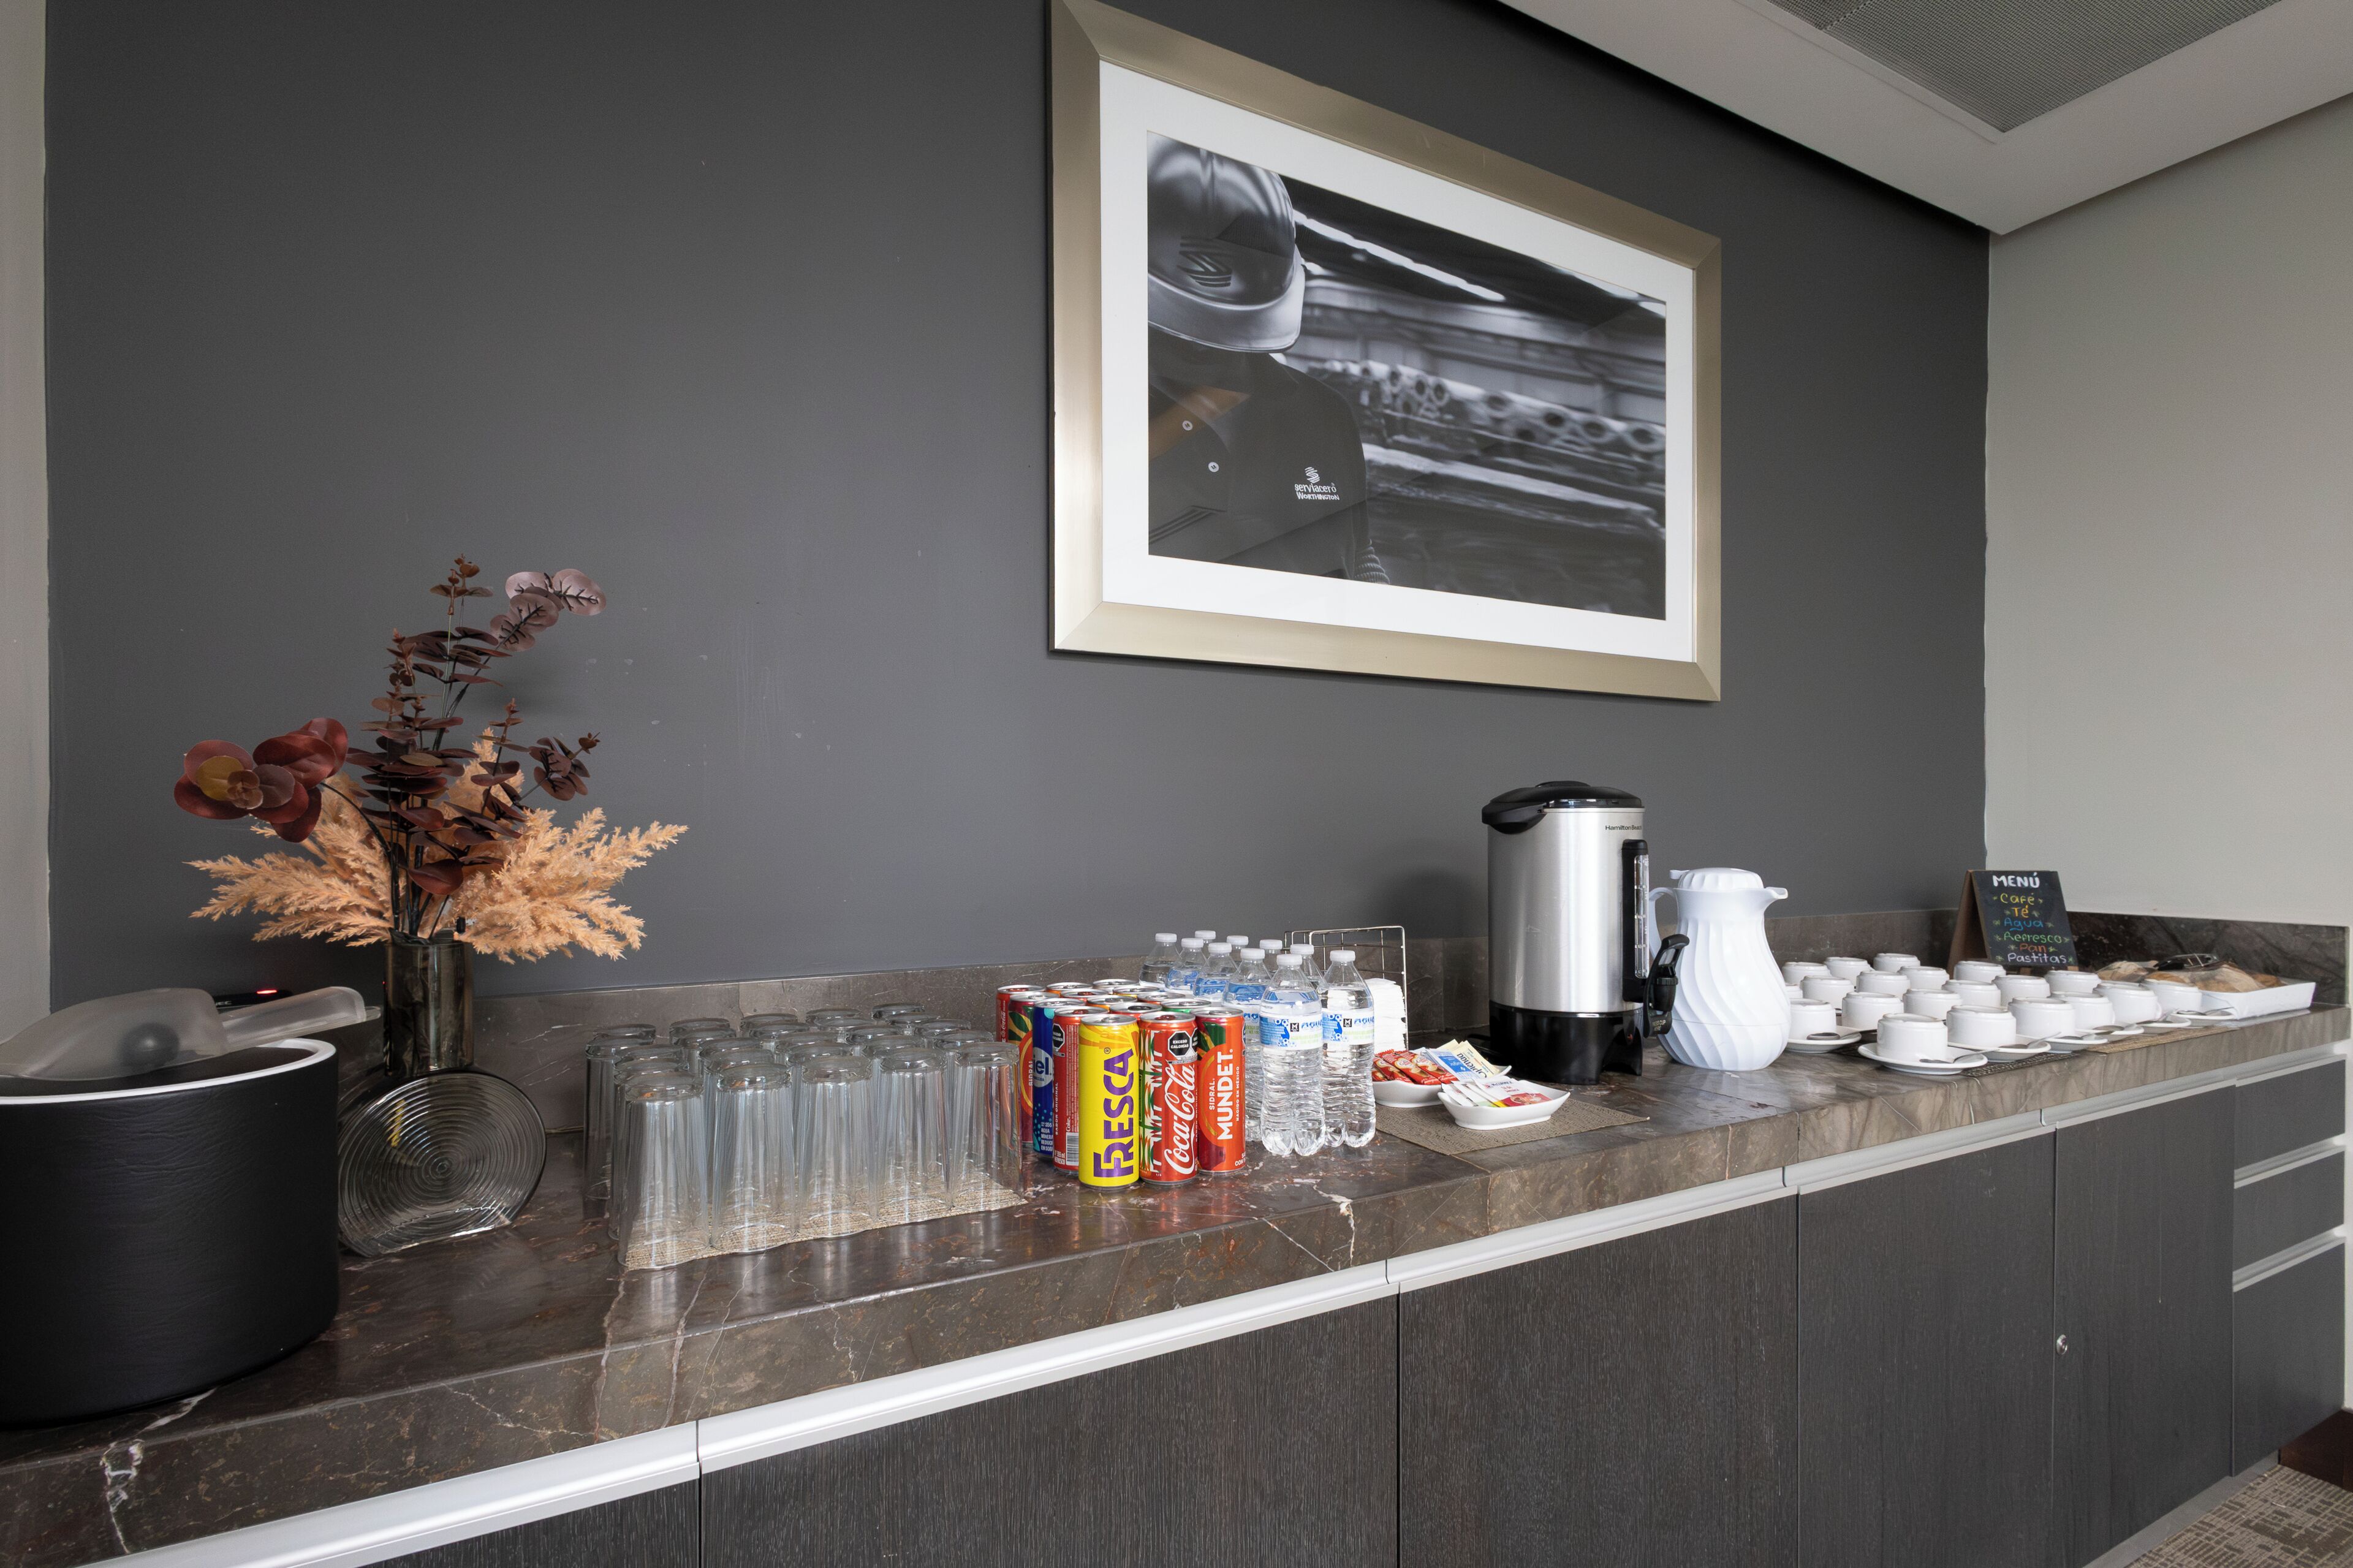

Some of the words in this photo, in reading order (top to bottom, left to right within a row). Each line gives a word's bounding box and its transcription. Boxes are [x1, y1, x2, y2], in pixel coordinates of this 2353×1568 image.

[1294, 483, 1337, 493] serviacero
[1296, 491, 1340, 500] WORTHINGTON
[1992, 872, 2040, 888] MENÚ
[1999, 892, 2035, 905] Café
[2010, 904, 2029, 918] Té
[2003, 917, 2044, 931] Agua
[2003, 931, 2062, 943] Refresco
[2019, 942, 2047, 953] Pan
[2007, 952, 2067, 963] Pastitas
[1217, 1050, 1233, 1140] MUNDET
[1235, 1089, 1240, 1098] EN
[1093, 1048, 1134, 1178] FRESCA
[1164, 1062, 1195, 1175] Coca-Cola
